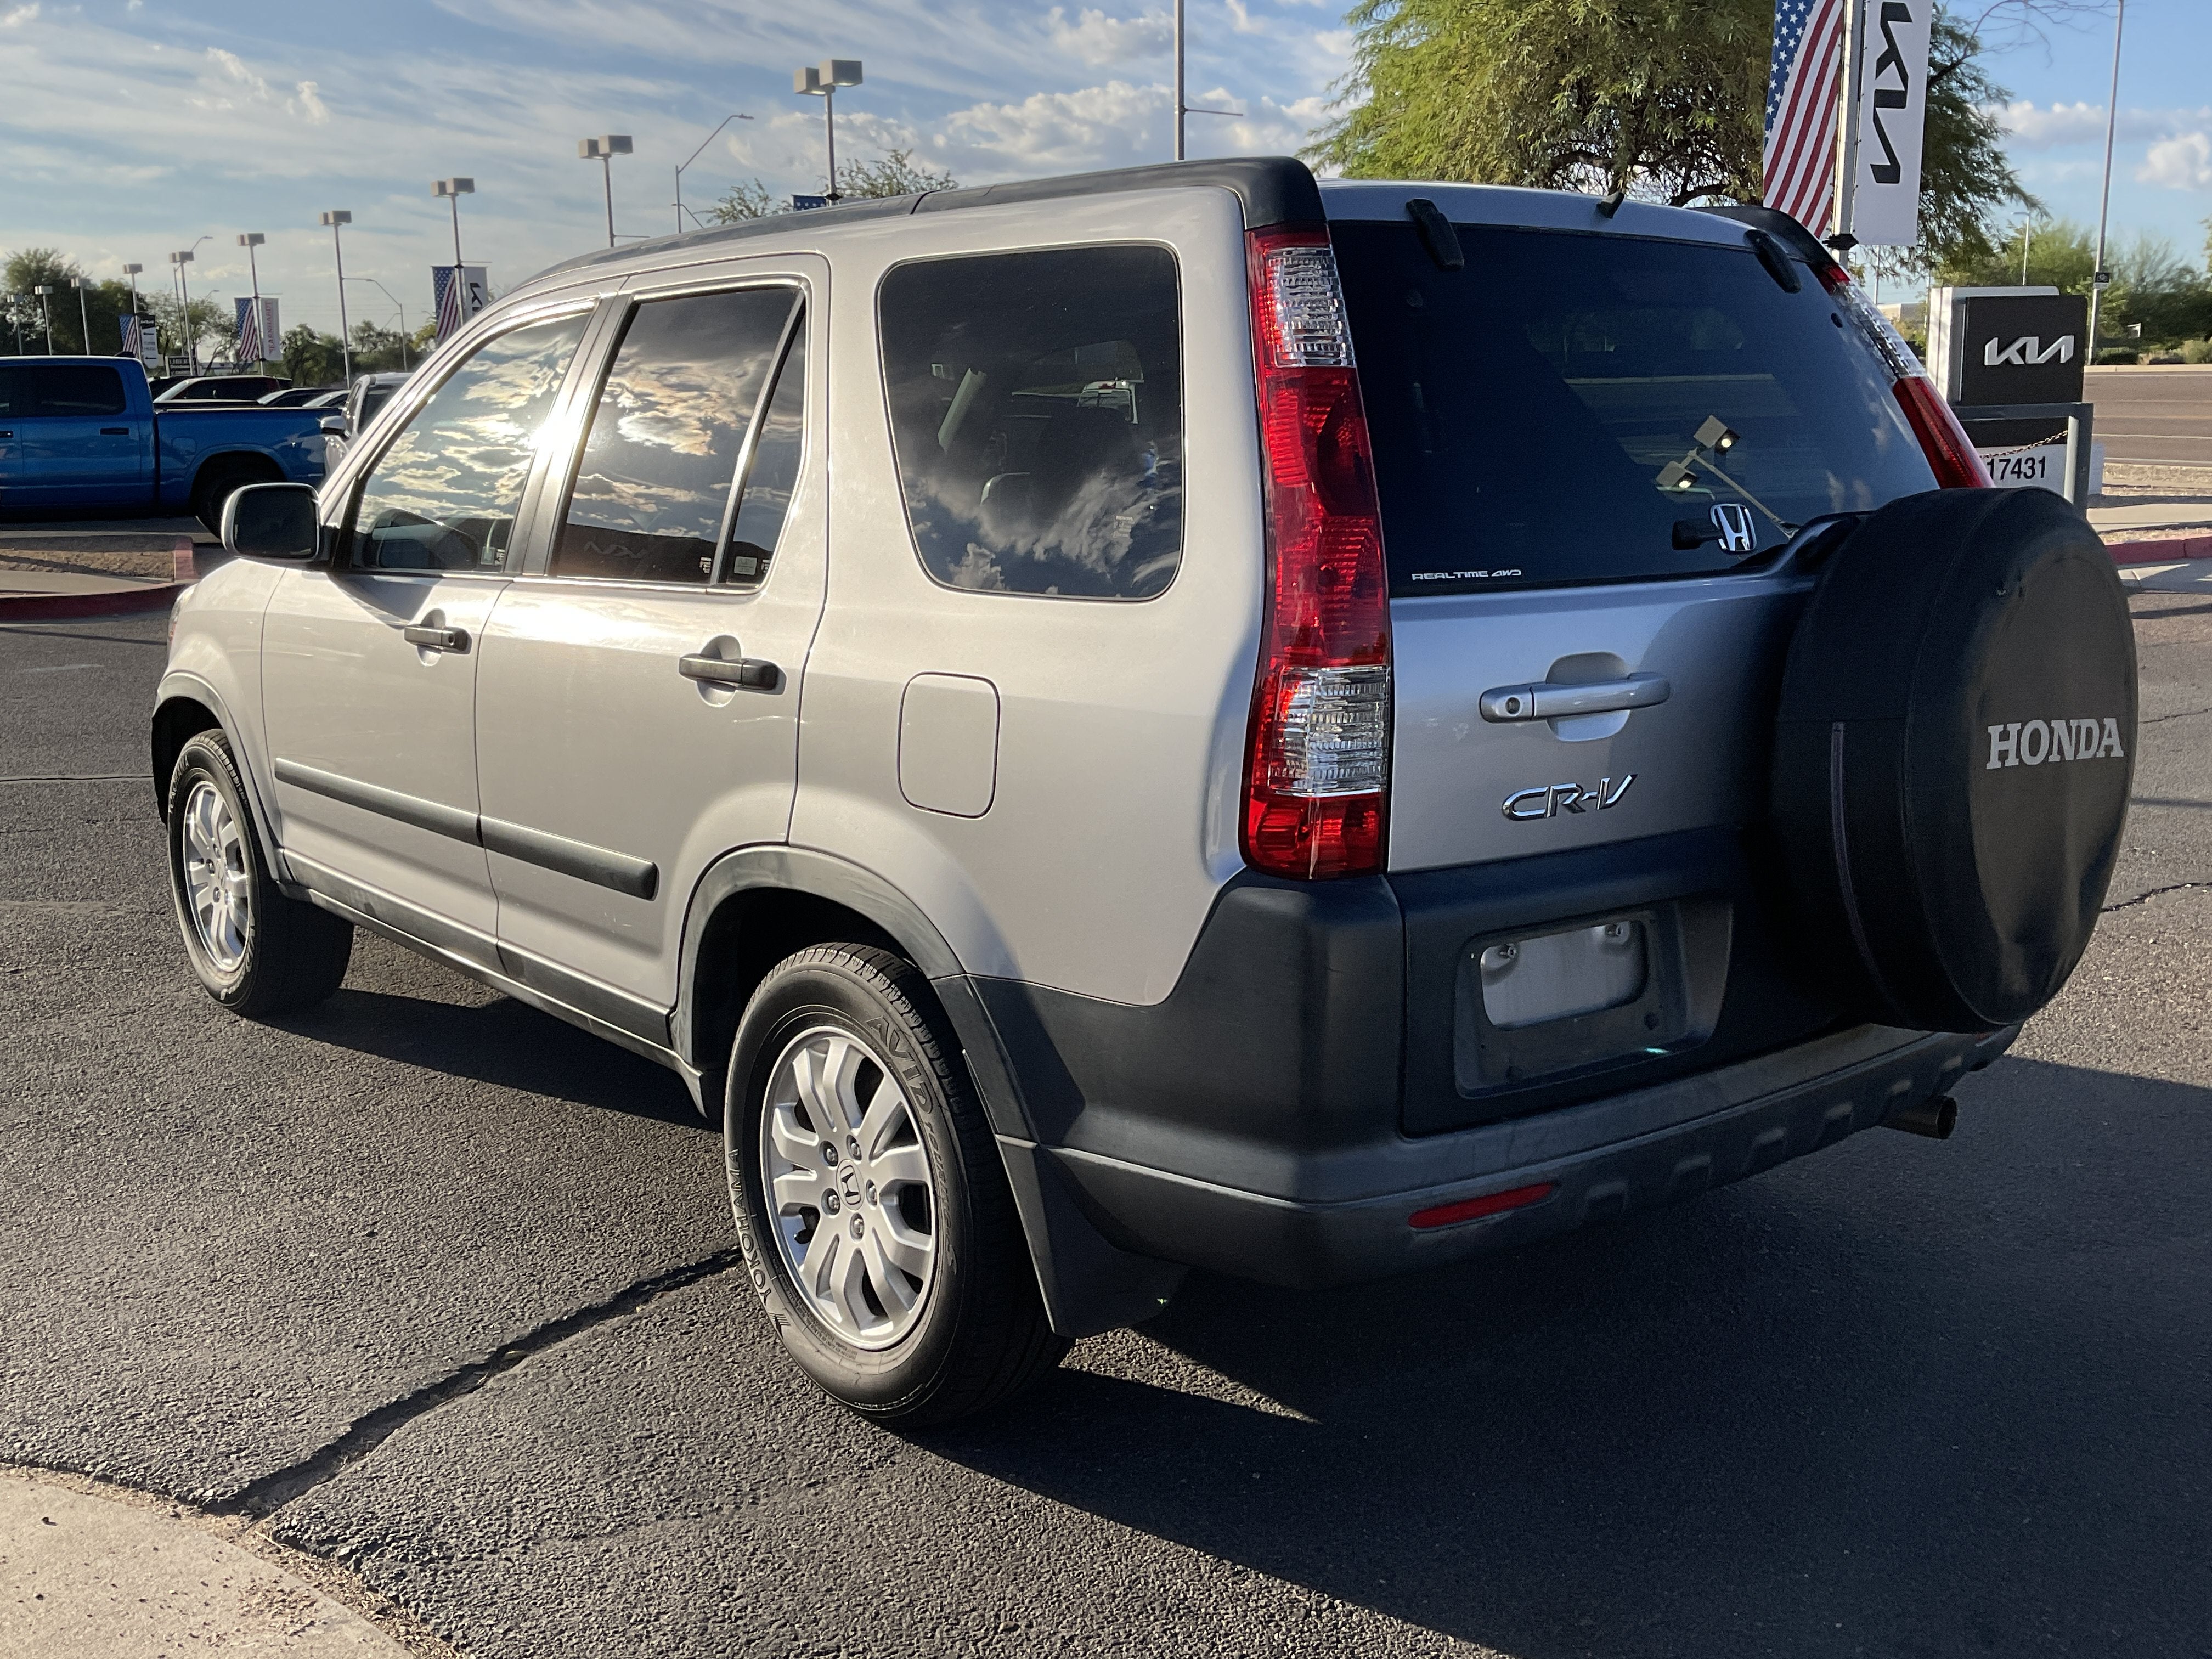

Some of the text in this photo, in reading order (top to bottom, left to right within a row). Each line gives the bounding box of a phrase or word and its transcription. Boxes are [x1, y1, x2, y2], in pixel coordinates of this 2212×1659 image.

[1870, 2, 1912, 184] KIA
[1984, 335, 2075, 366] KIA
[1987, 456, 2046, 481] 17431
[1986, 718, 2124, 770] HONDA
[1502, 774, 1638, 821] CR-V
[728, 1148, 772, 1307] YOKOHAMA
